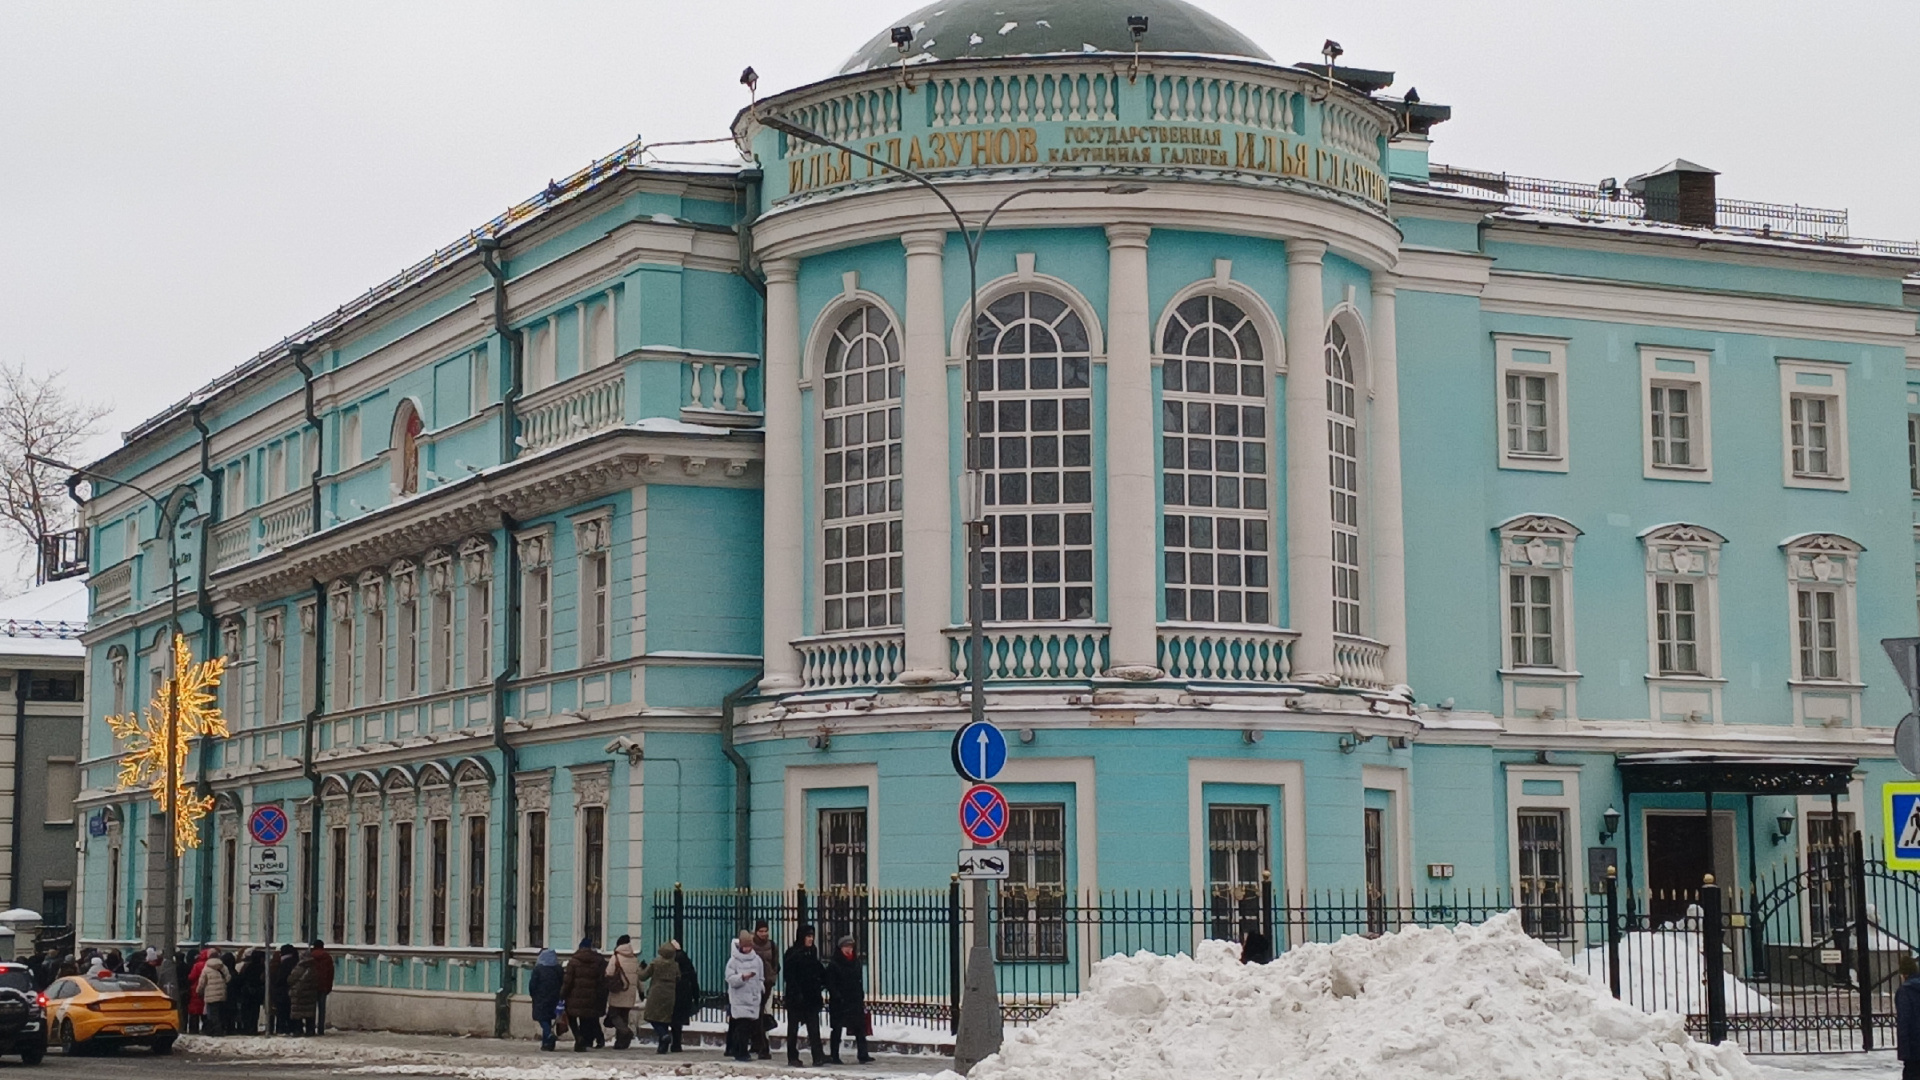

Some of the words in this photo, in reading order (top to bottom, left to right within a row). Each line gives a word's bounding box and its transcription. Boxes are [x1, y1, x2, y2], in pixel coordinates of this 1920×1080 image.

[1048, 146, 1151, 164] КАРТИННАЯ
[1161, 148, 1229, 166] ГАЛЕРЕЯ
[1064, 126, 1222, 147] ГОСУДАРСТВЕННАЯ
[788, 150, 851, 194] ИЛЬЯ
[865, 127, 1038, 178] ГЛАЗУНОВ
[1235, 131, 1309, 178] ИЛЬЯ
[1316, 148, 1388, 204] ГЛАЗУНО
